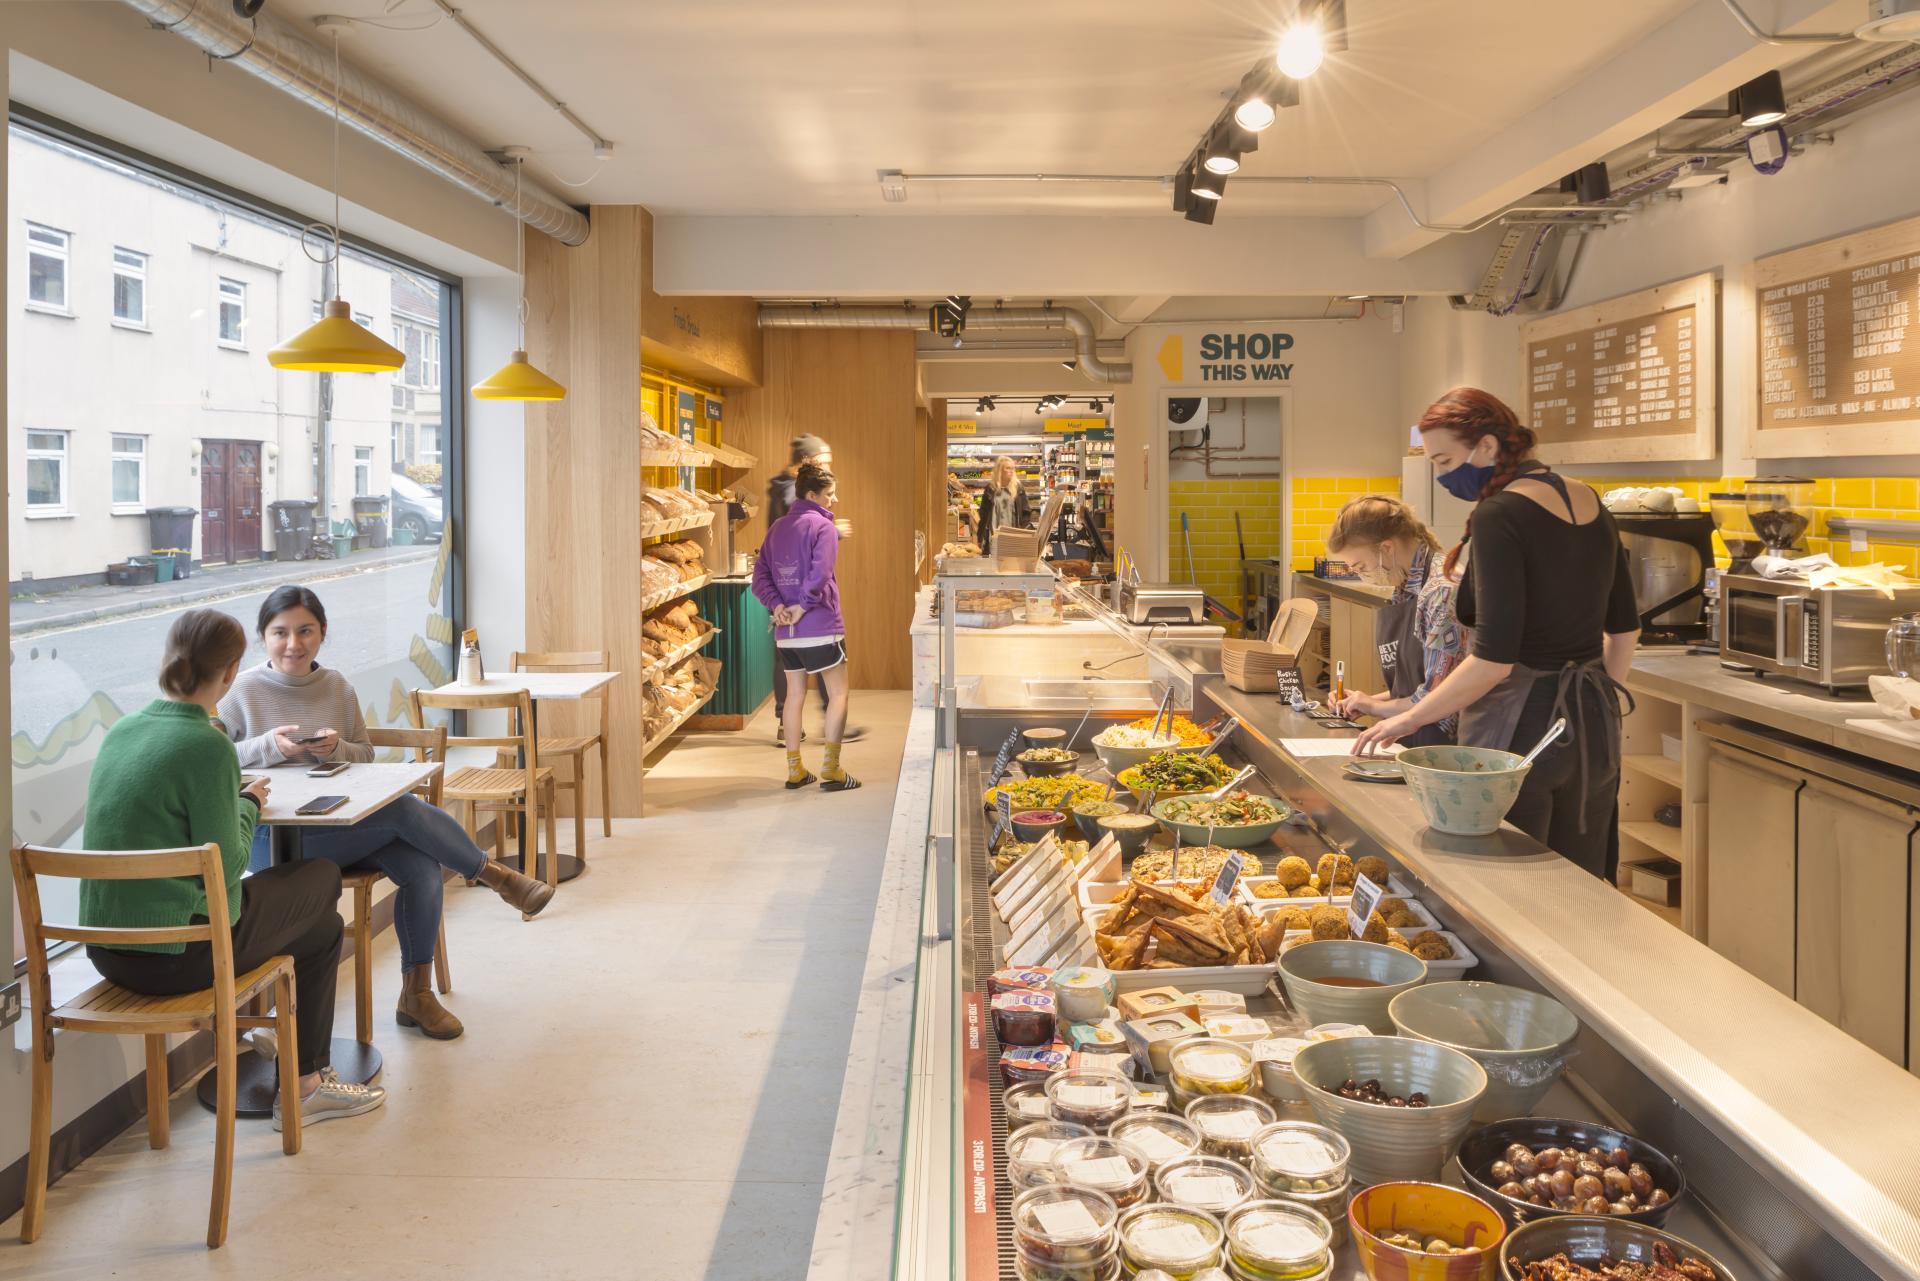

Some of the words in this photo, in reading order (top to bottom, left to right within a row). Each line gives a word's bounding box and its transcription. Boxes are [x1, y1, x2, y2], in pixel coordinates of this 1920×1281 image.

[1889, 302, 1909, 315] LATTE
[1889, 315, 1909, 328] LATTE
[1200, 333, 1294, 360] SHOP
[1200, 364, 1247, 381] THIS
[1251, 363, 1294, 381] WAY
[1872, 367, 1893, 380] LATTE
[1379, 640, 1399, 654] BETT
[1381, 651, 1397, 664] FOO
[973, 1145, 985, 1159] FOR
[973, 1176, 986, 1213] ANTIPASTI
